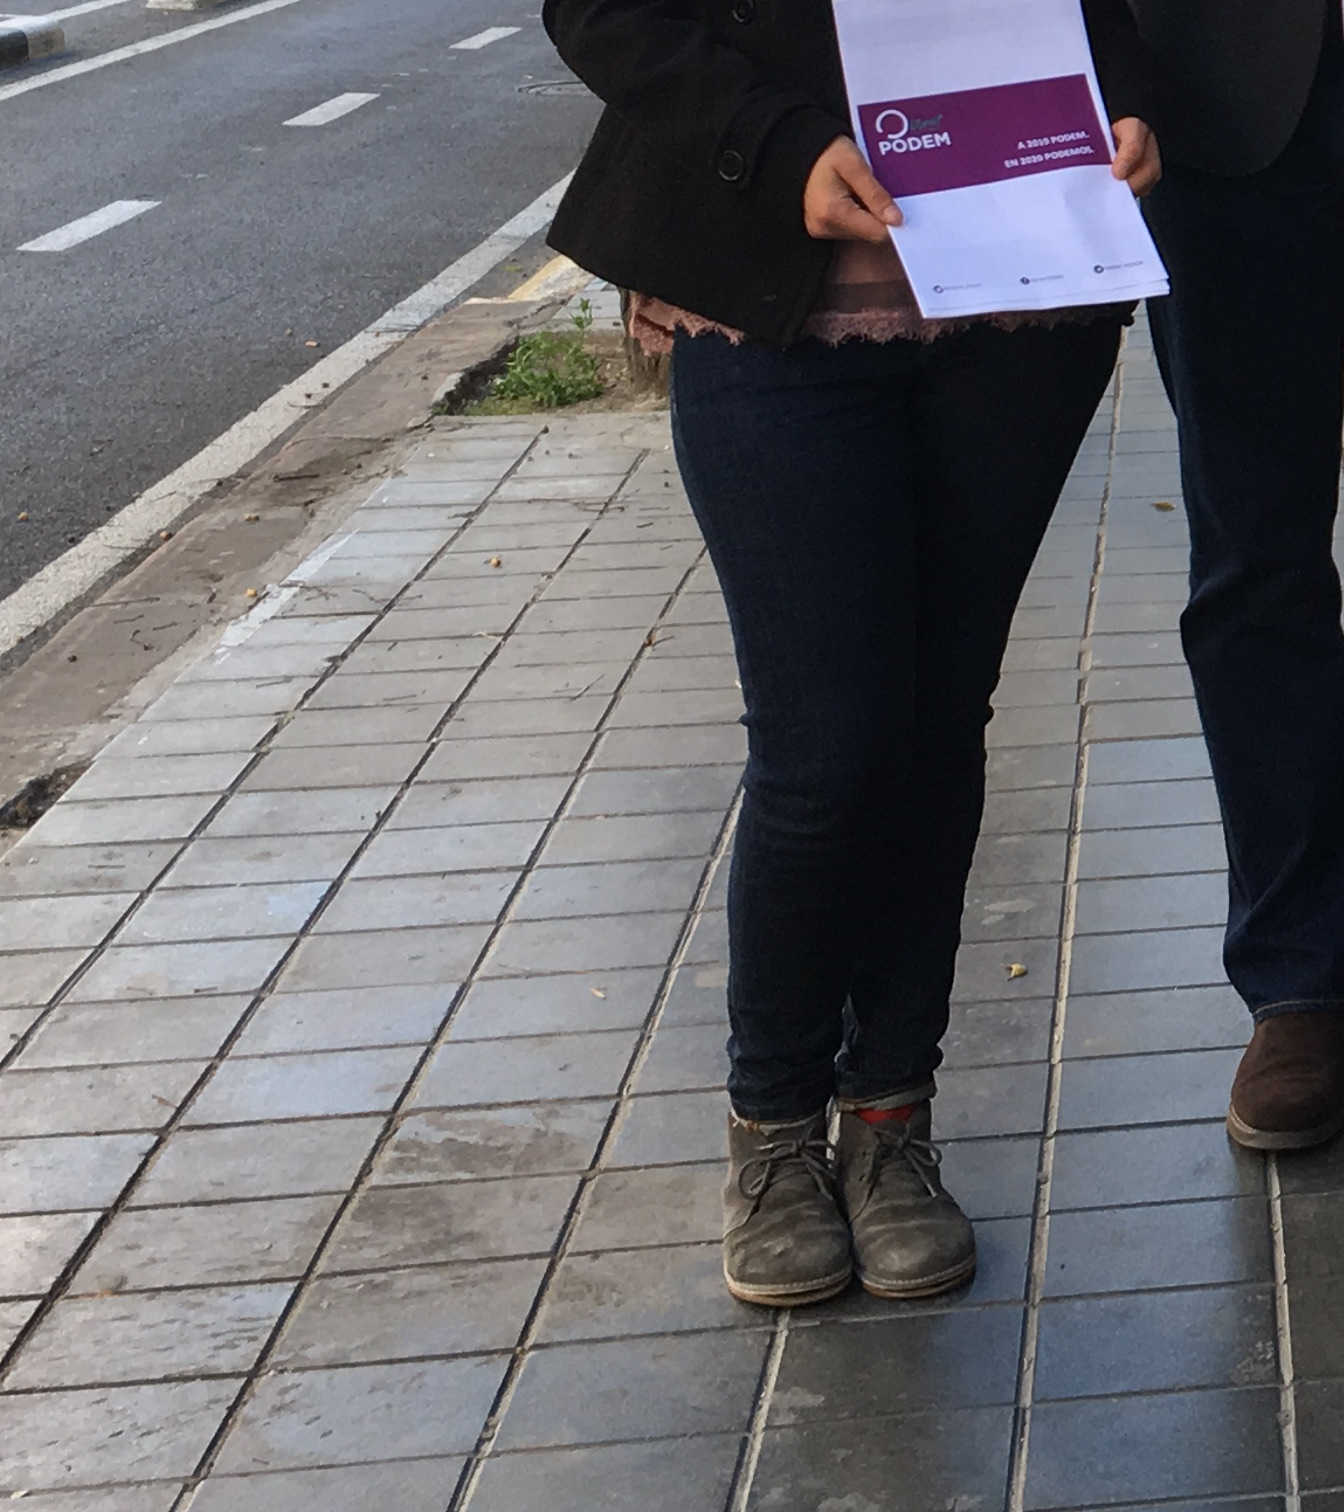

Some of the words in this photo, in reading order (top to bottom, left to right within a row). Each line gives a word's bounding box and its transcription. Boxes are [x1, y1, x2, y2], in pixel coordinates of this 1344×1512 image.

[878, 131, 952, 156] PODEM
[1017, 141, 1026, 150] A
[1004, 158, 1019, 168] EN
